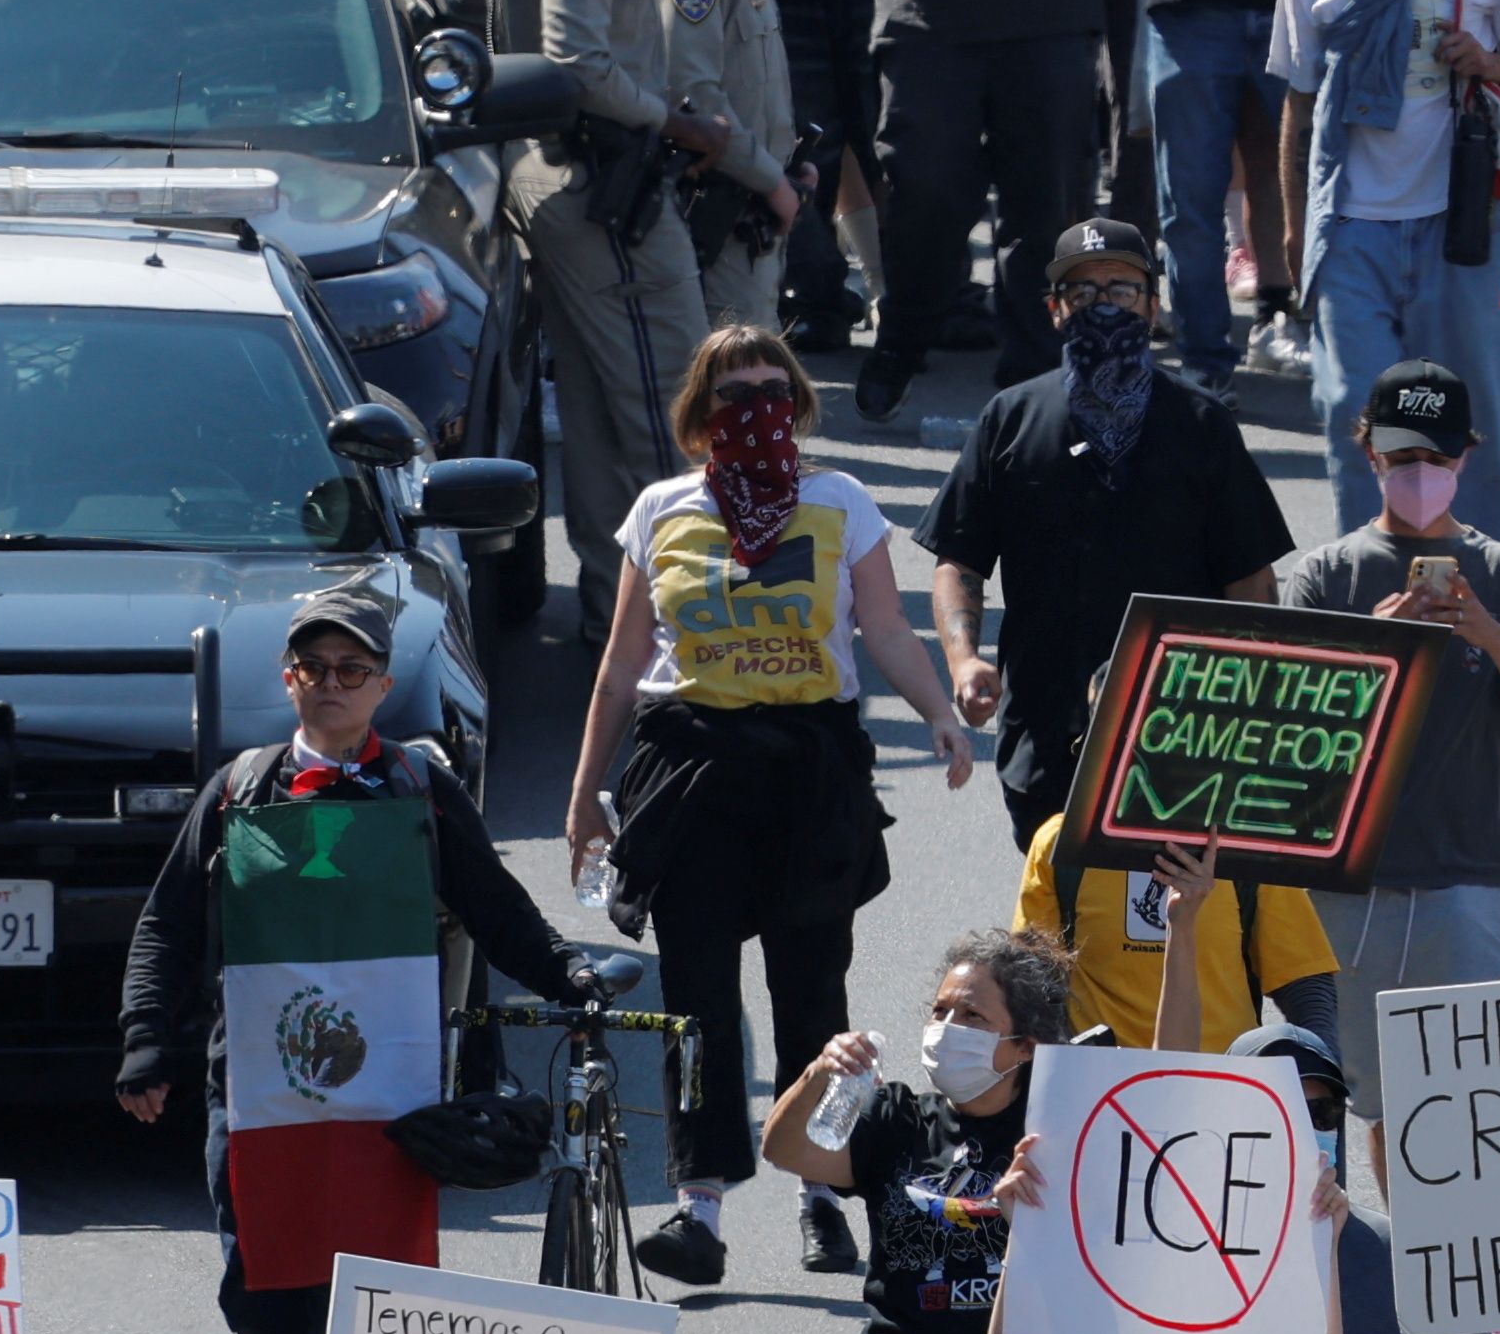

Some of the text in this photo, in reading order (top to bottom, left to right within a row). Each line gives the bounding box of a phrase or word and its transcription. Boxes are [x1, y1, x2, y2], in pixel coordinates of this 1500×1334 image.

[1081, 225, 1106, 251] LA
[694, 637, 822, 666] DEPECHE
[733, 656, 825, 677] MODE
[1158, 649, 1386, 723] THEN THEY
[1138, 707, 1365, 776] CAME FOR
[1113, 1128, 1272, 1257] ICE
